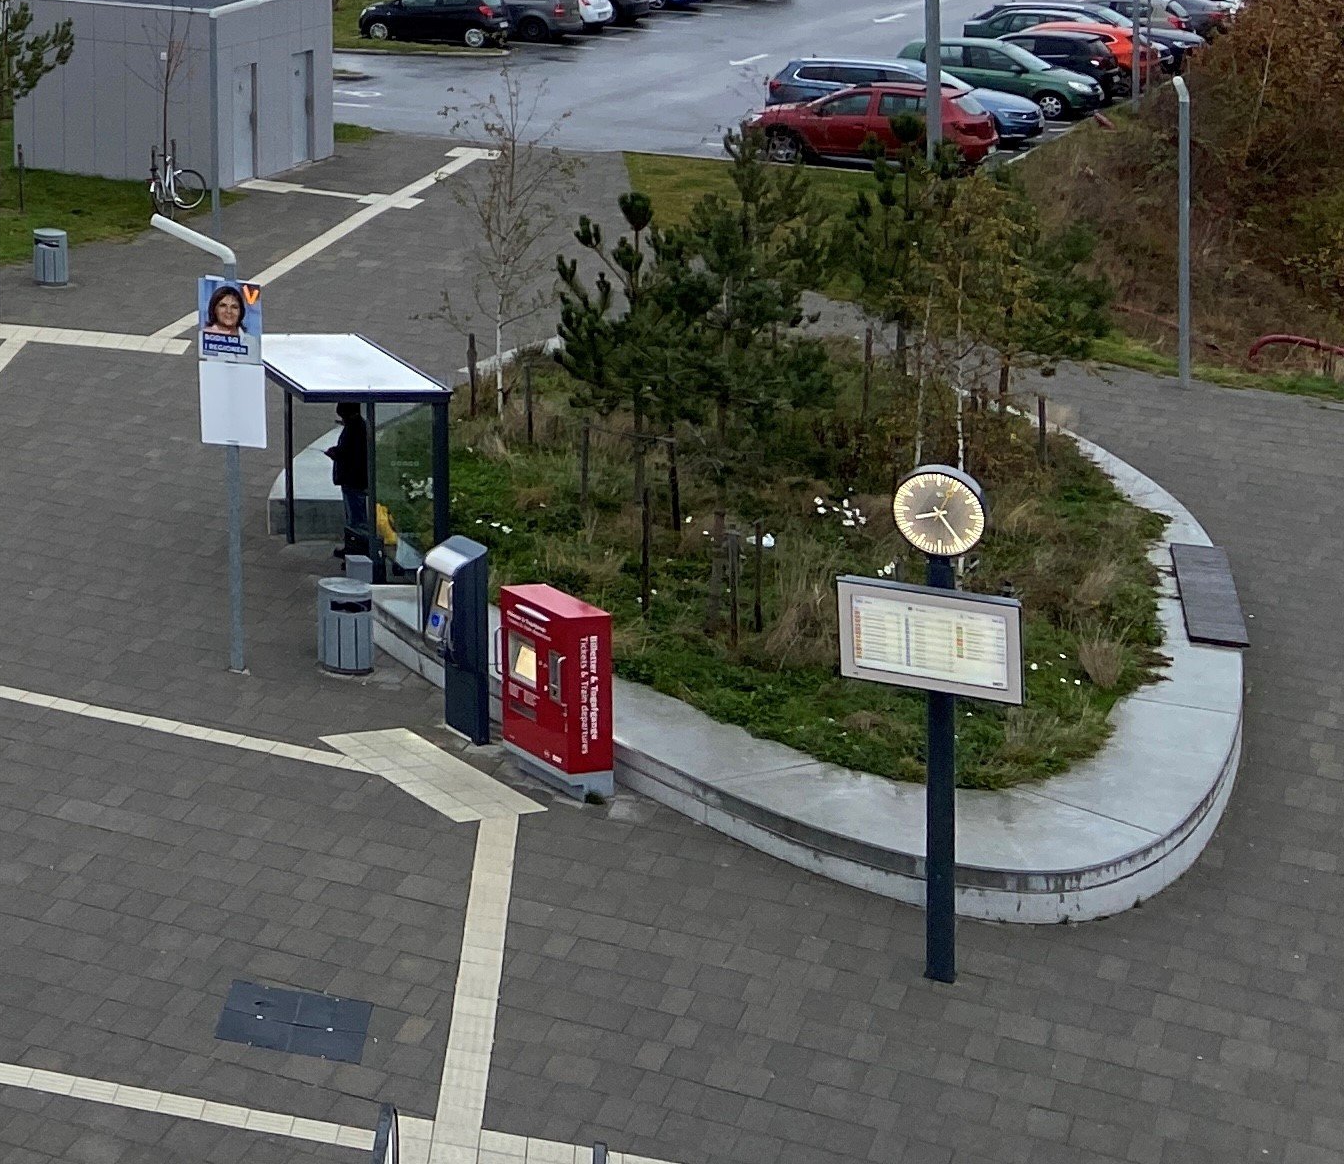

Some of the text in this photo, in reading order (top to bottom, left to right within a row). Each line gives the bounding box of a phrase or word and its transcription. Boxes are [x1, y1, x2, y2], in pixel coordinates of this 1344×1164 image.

[243, 284, 259, 304] V
[580, 636, 588, 668] Tickets
[591, 676, 598, 684] &
[581, 681, 589, 703] Train
[580, 705, 589, 754] departures
